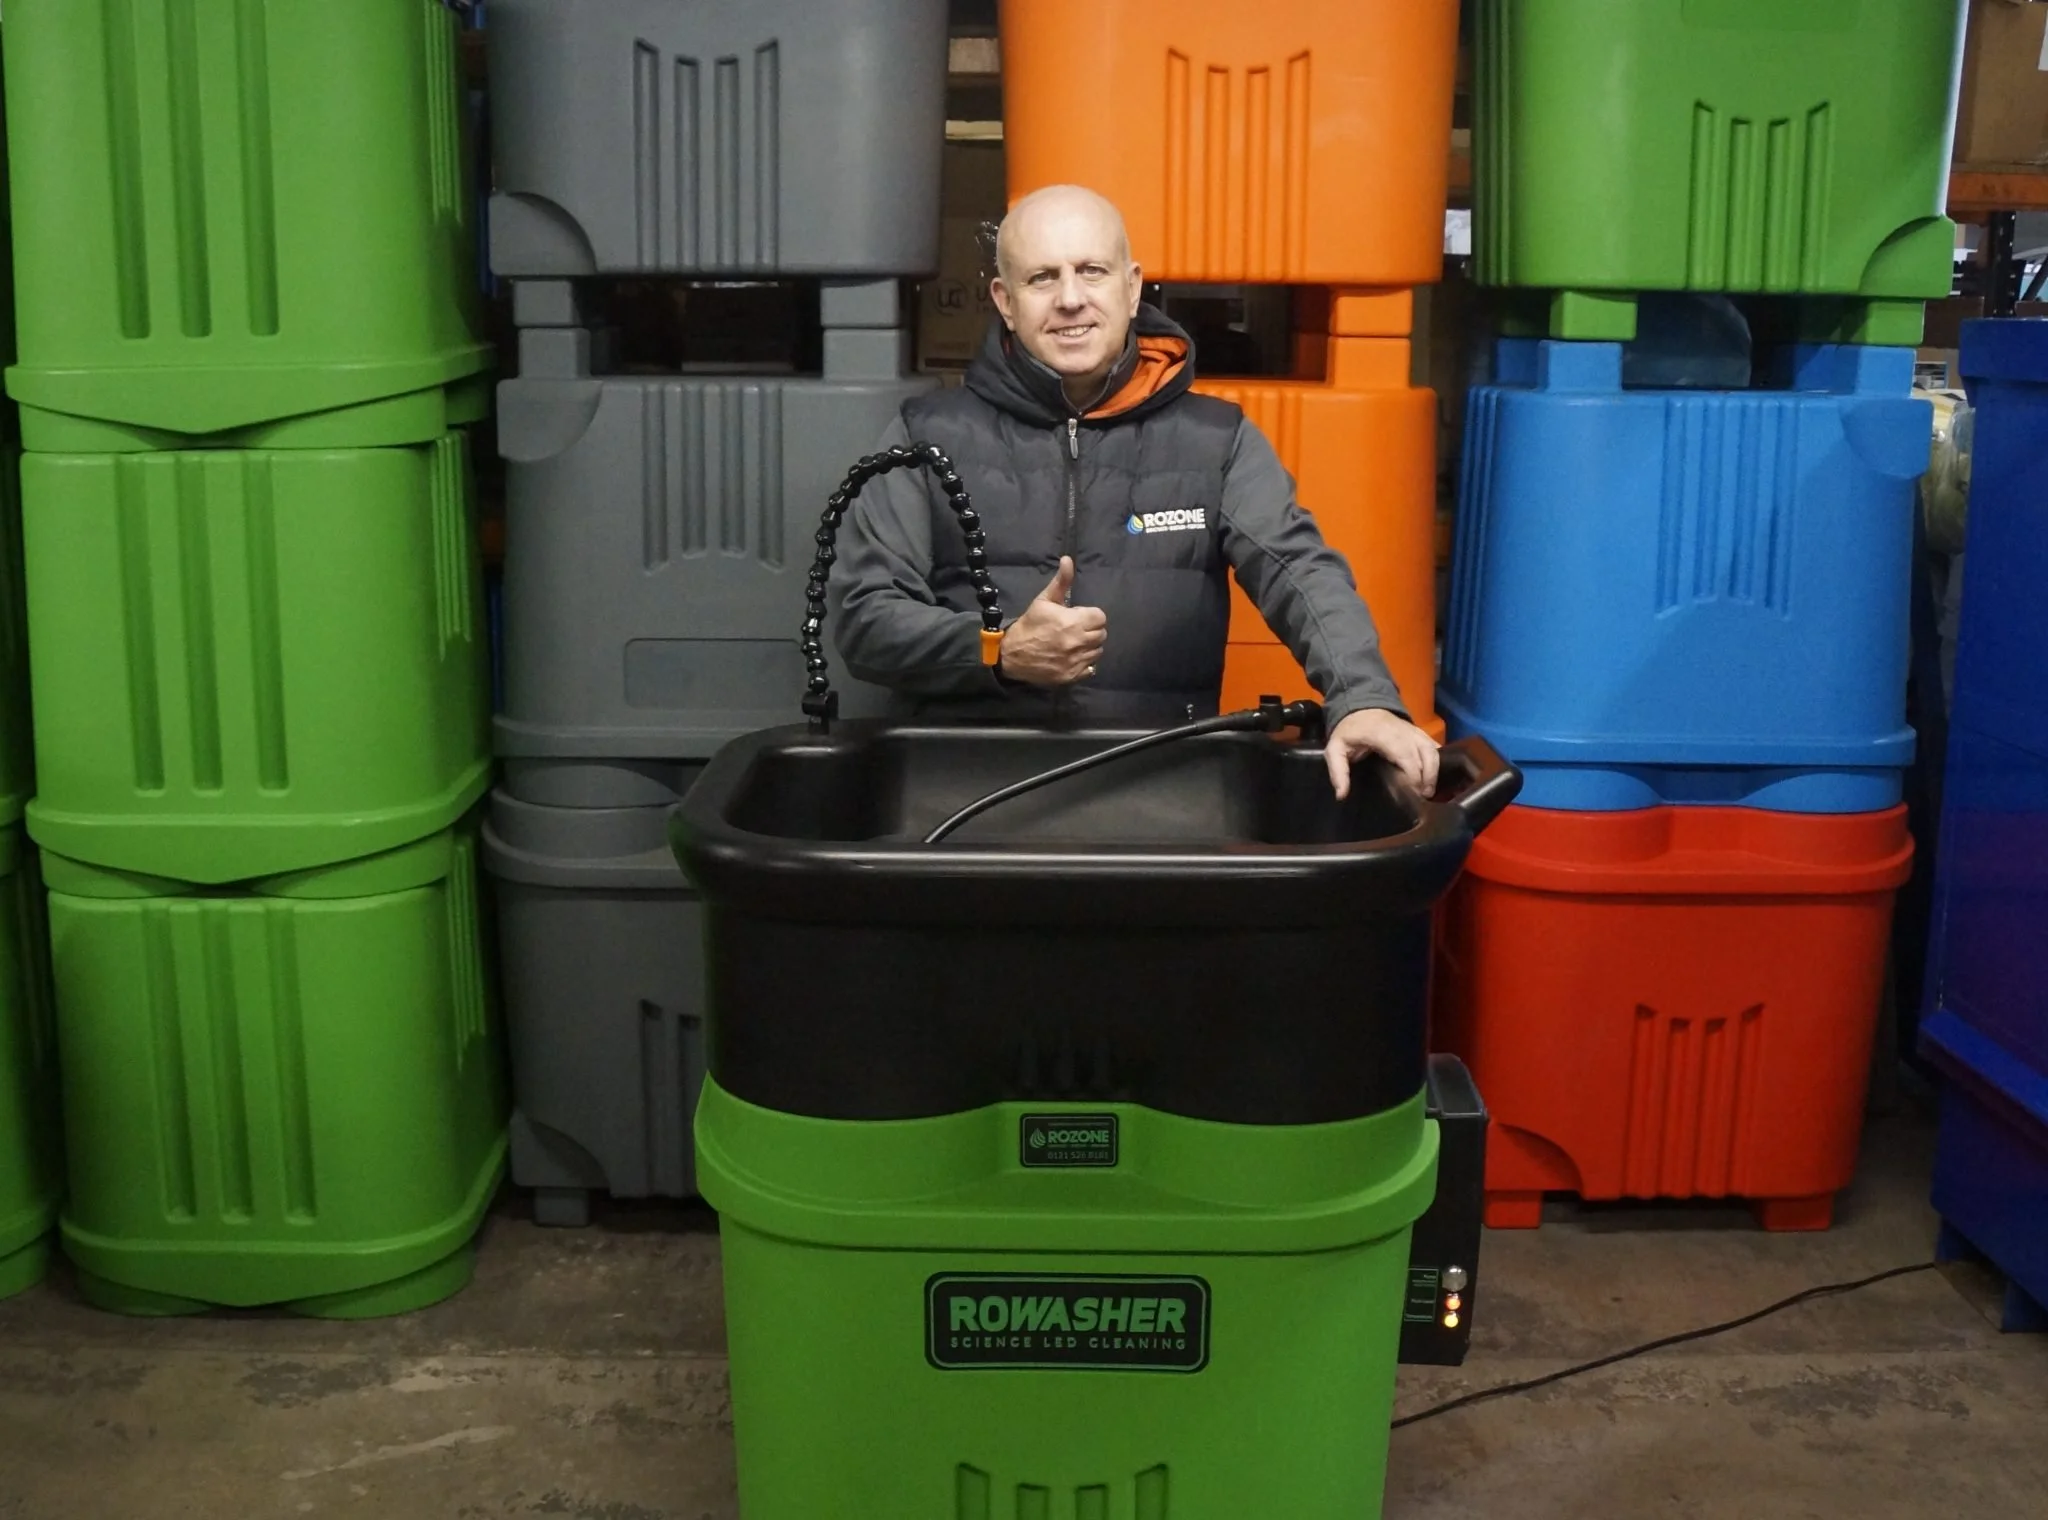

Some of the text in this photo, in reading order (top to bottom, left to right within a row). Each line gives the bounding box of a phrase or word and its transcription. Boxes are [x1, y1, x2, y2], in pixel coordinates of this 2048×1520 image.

[1143, 508, 1205, 527] ROZONE
[1048, 1130, 1109, 1143] ROZONE
[950, 1296, 1186, 1333] ROWASHER
[950, 1336, 1186, 1350] SCIENCE LED CLEANING
